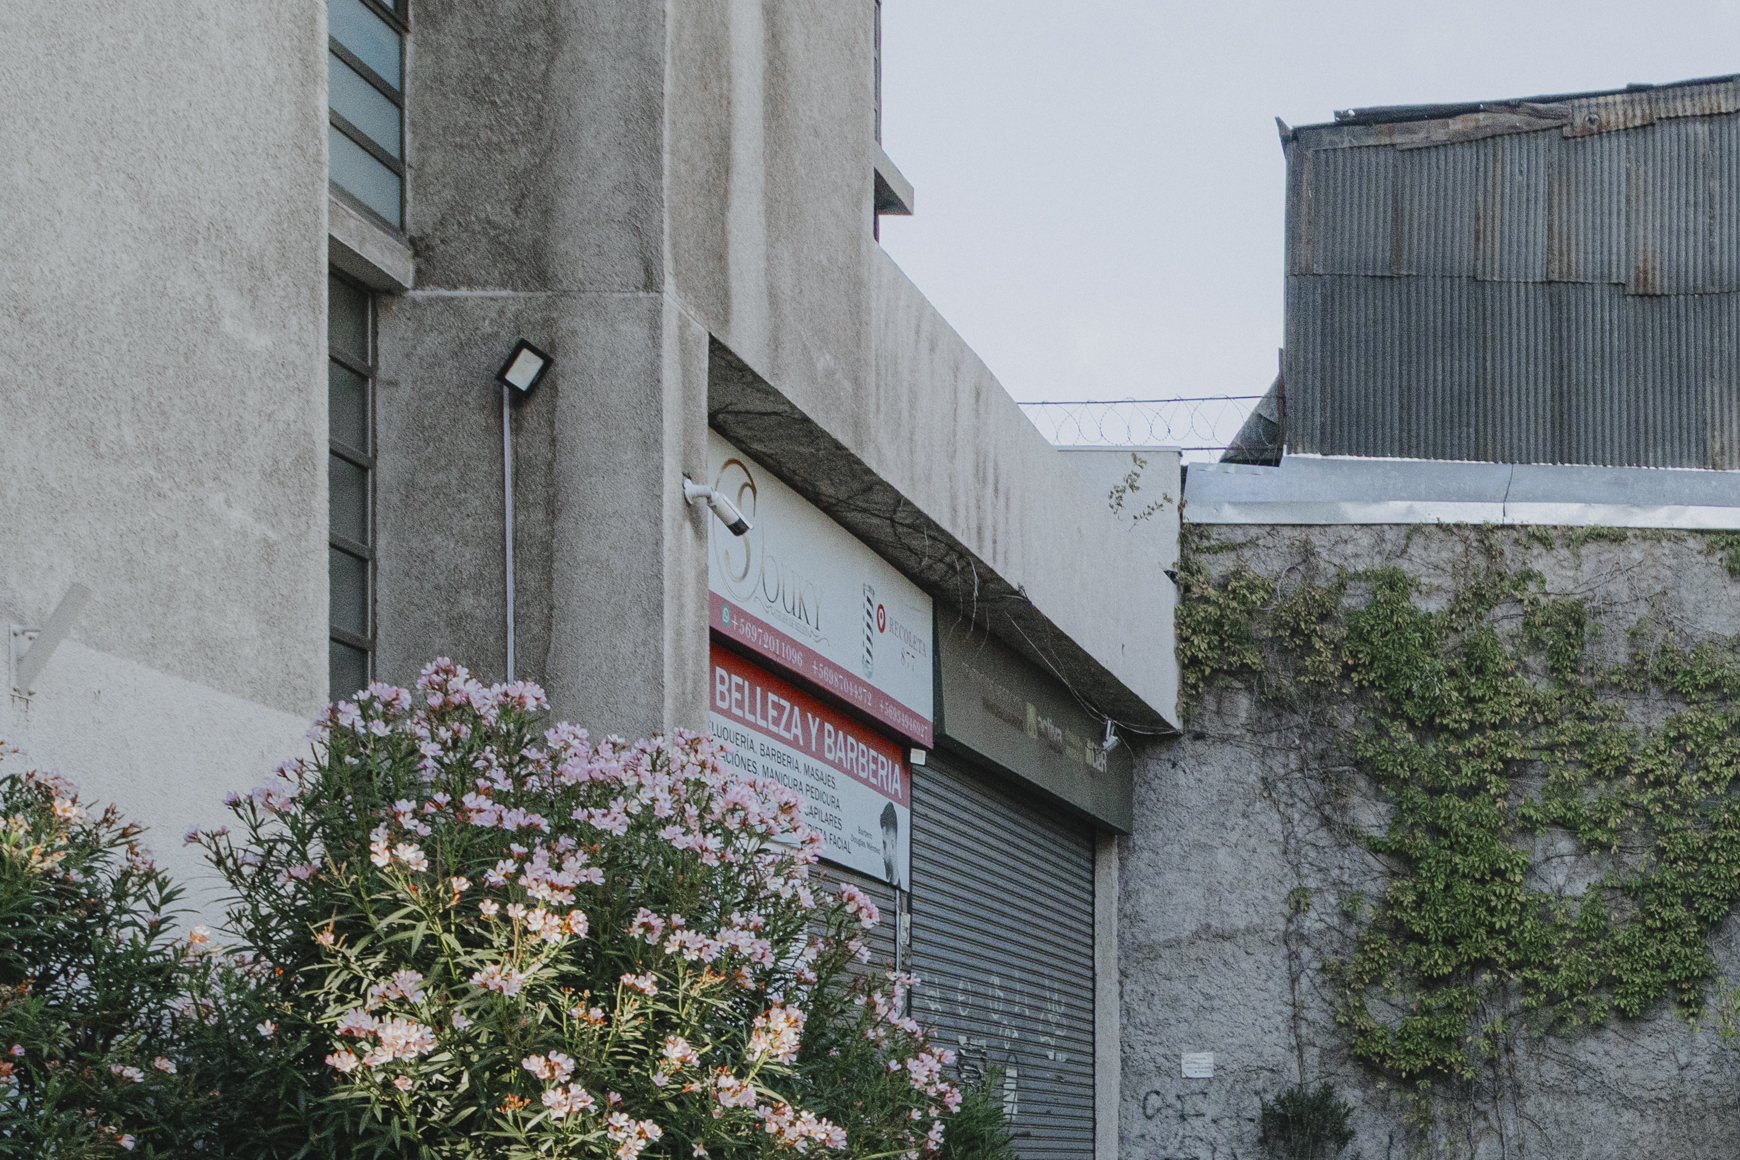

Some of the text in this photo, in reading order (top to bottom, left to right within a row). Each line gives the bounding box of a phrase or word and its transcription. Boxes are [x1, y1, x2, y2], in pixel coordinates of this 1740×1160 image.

[731, 614, 803, 667] +56972011096
[889, 616, 927, 658] RECOLETA
[901, 648, 916, 672] 877
[715, 666, 804, 746] BELLEZA
[807, 712, 820, 752] Y
[824, 722, 902, 799] BARBERIA
[709, 720, 758, 755] LUQUERÍA.
[803, 762, 838, 791] MASAJES.
[762, 764, 804, 795] MANICURA
[829, 833, 852, 854] FACIAL
